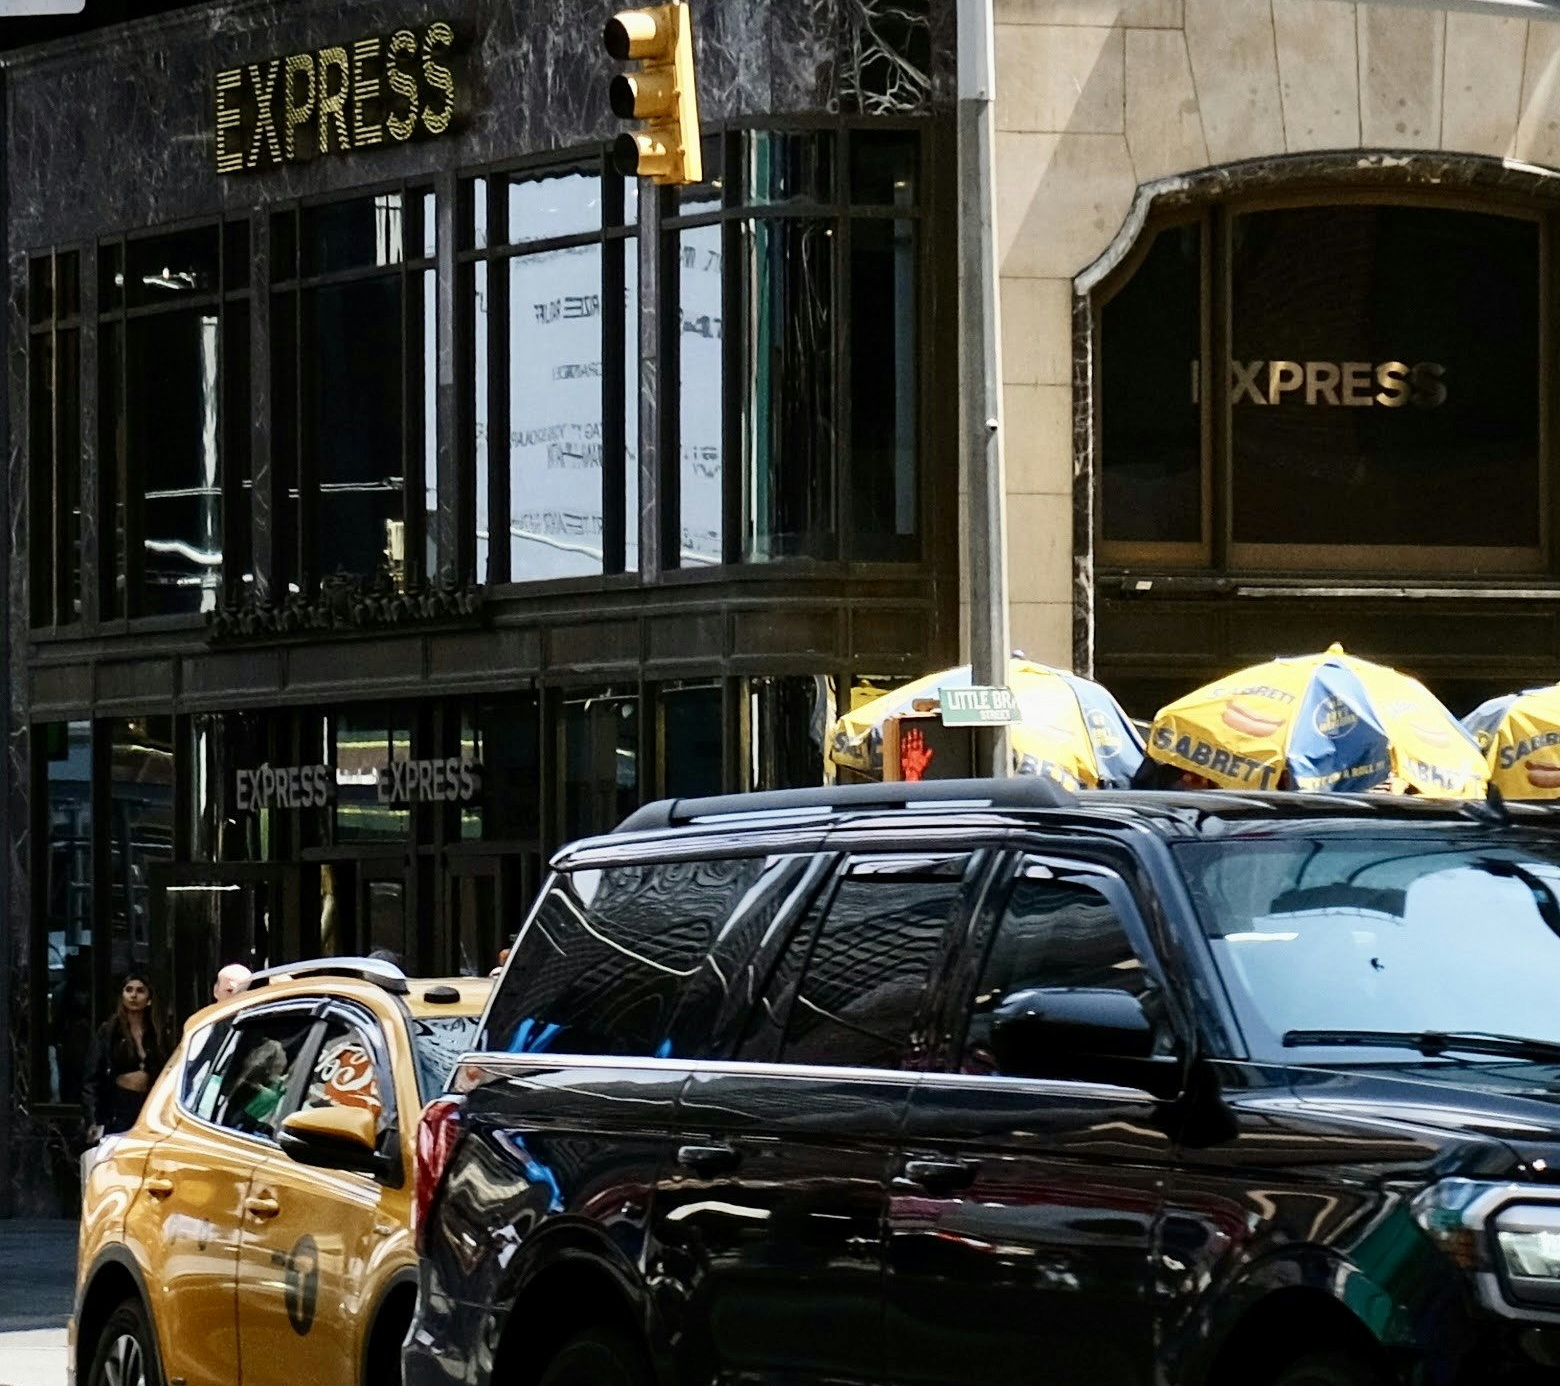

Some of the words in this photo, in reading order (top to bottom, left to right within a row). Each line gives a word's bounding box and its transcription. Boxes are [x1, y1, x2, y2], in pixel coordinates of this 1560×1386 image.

[215, 20, 457, 176] EXPRESS
[947, 691, 989, 711] LITTLE
[993, 691, 1019, 710] BRA
[377, 756, 478, 806] EXPRESS
[1151, 725, 1277, 792] SABRETT
[235, 763, 329, 812] EXPRESS
